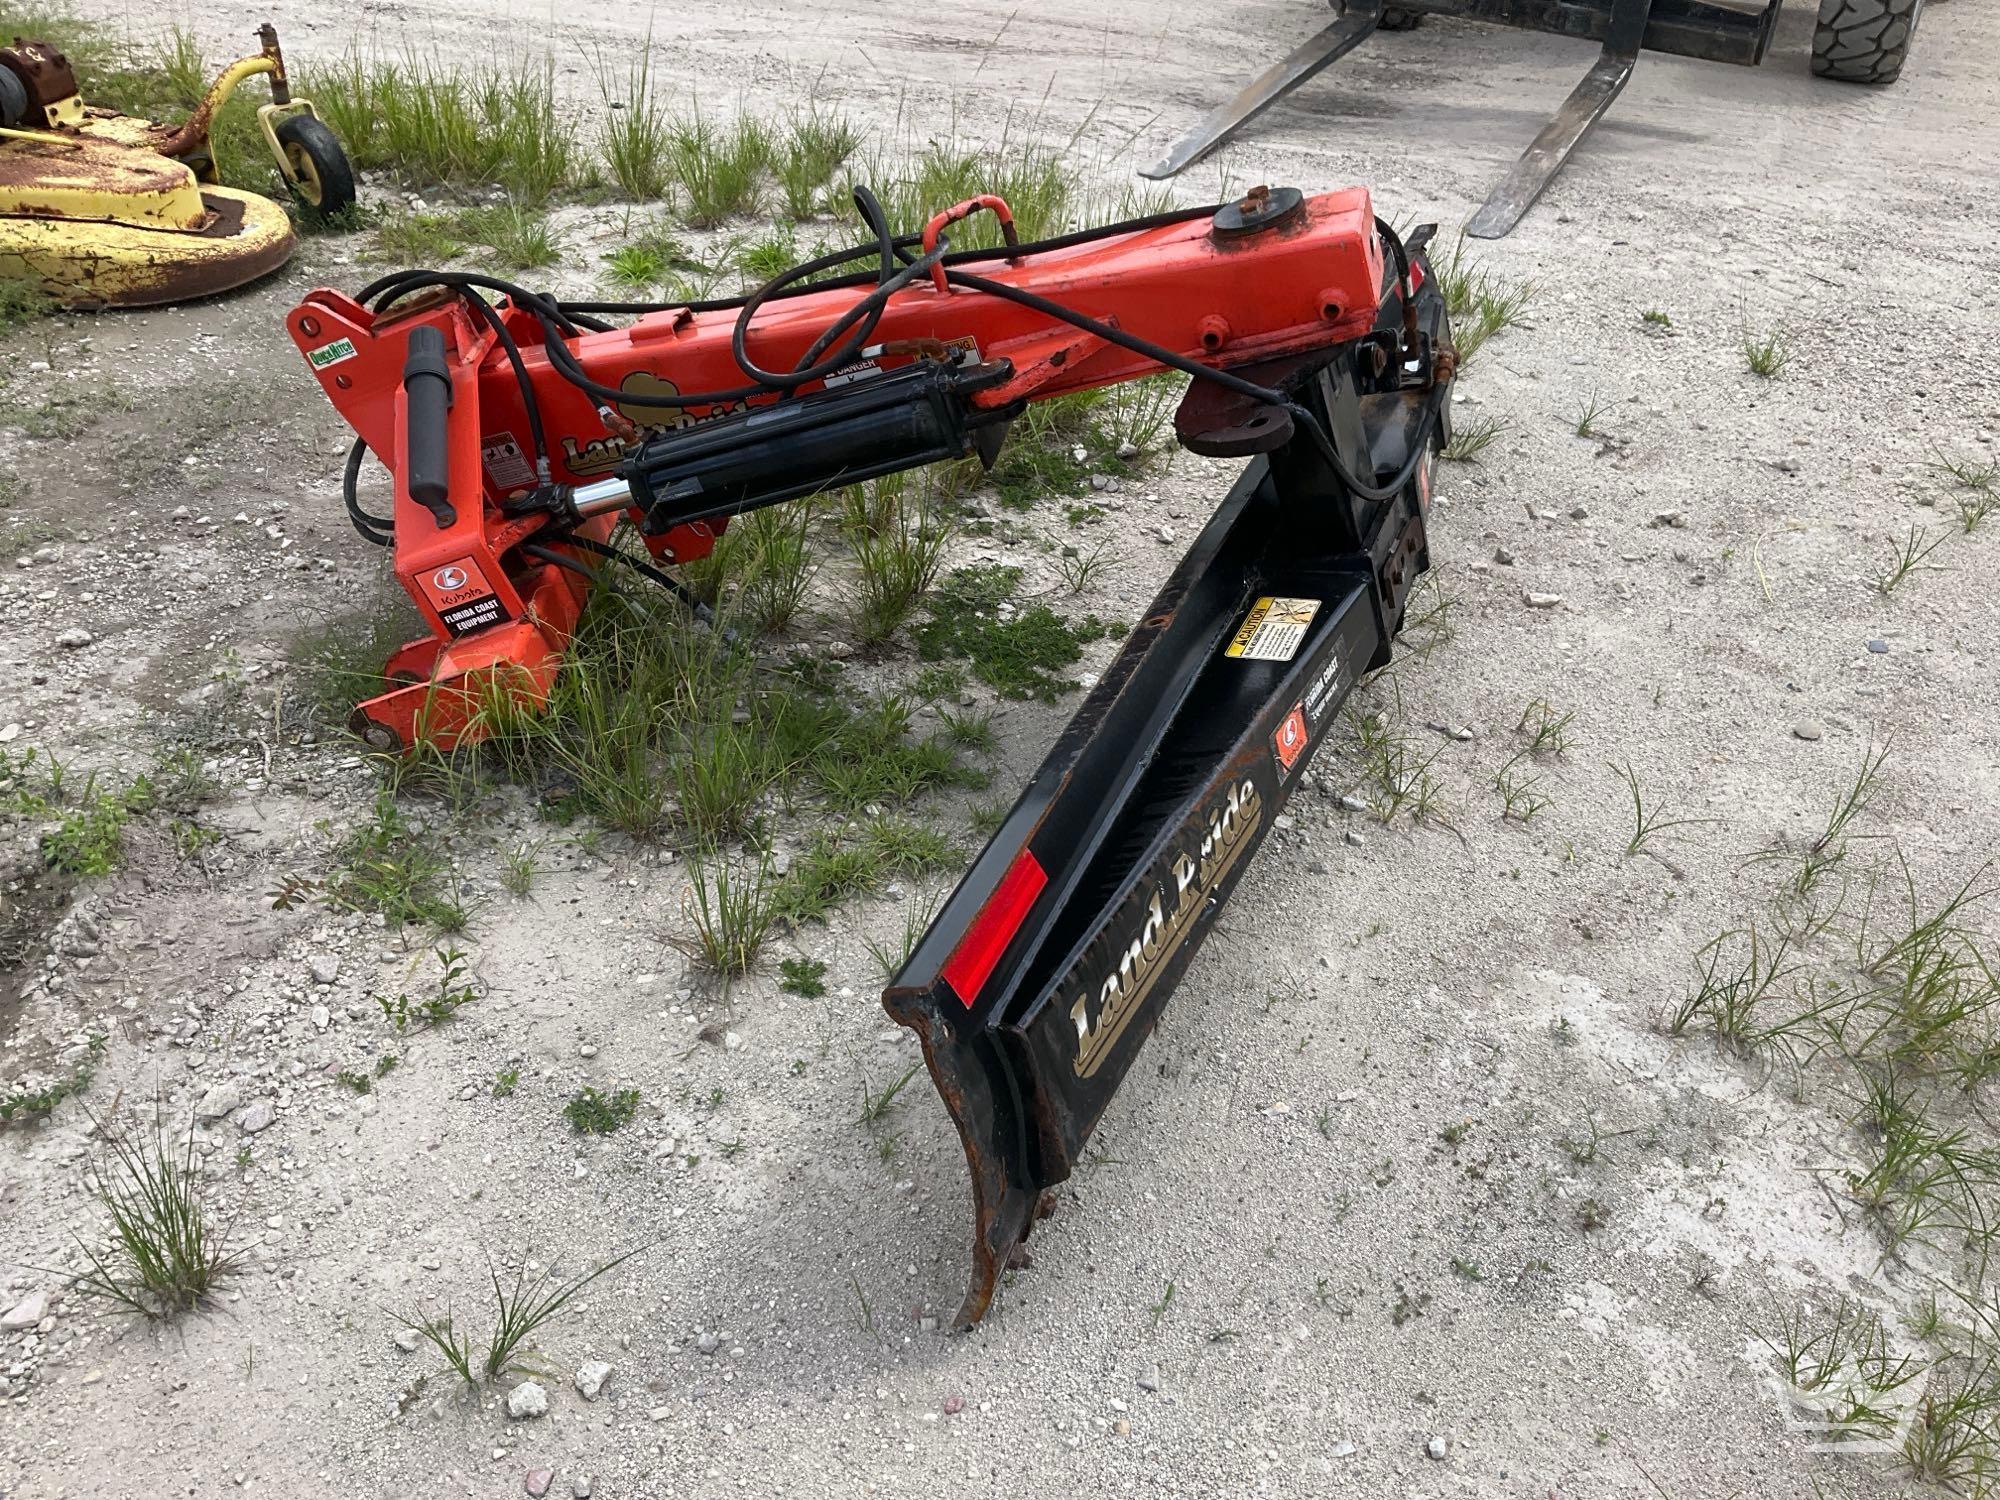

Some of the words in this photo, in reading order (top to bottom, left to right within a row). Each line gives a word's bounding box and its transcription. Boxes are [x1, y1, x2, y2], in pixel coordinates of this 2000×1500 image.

[441, 587, 483, 605] Kubota
[443, 607, 476, 624] FLORIDA
[474, 599, 500, 613] COAST
[456, 610, 499, 631] EQUIPMENT
[1239, 608, 1266, 640] CAUTION
[1322, 656, 1339, 685] COAST
[1070, 889, 1168, 1066] Land
[1171, 779, 1257, 918] Pride
